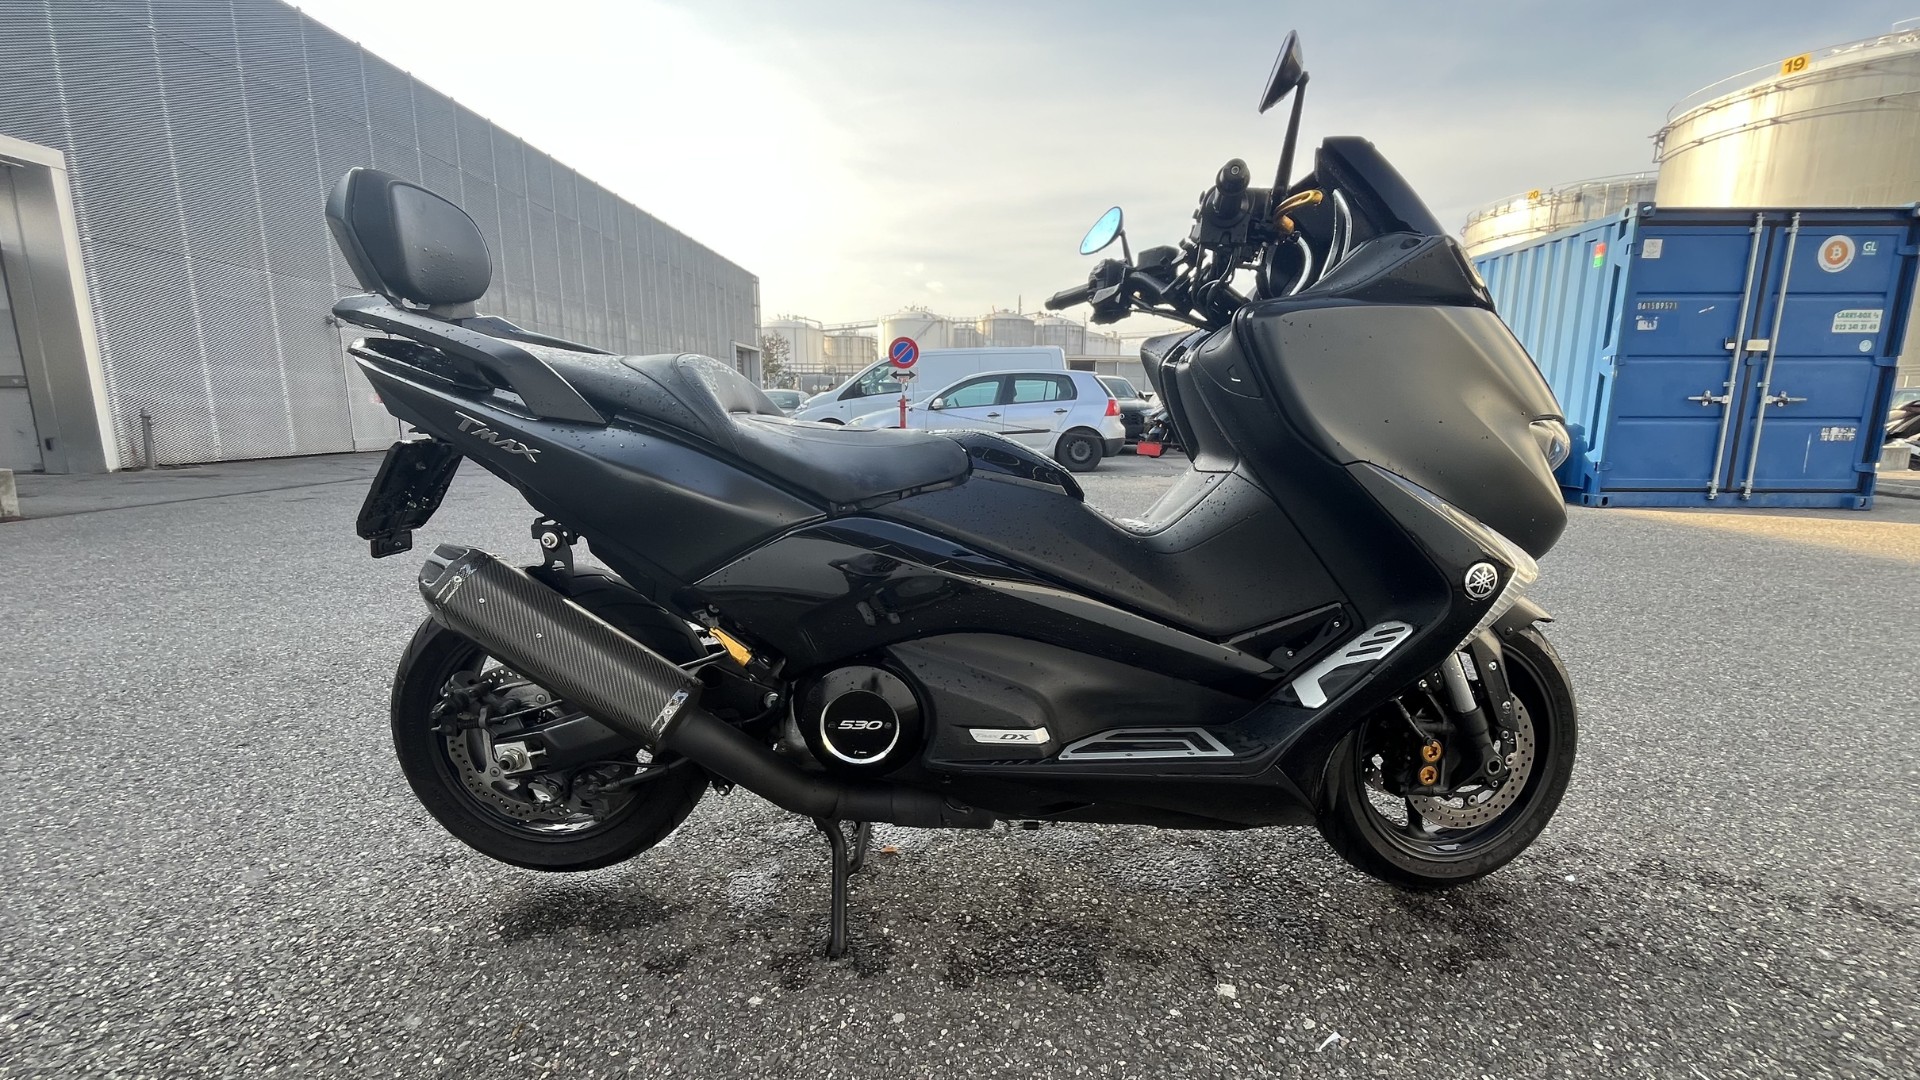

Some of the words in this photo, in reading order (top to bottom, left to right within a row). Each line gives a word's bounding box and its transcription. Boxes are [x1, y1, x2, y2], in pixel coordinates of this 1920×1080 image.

[1784, 57, 1806, 73] 19
[1862, 241, 1877, 251] GL
[454, 410, 542, 463] TMAX
[837, 720, 883, 730] 530
[1000, 733, 1031, 741] DX
